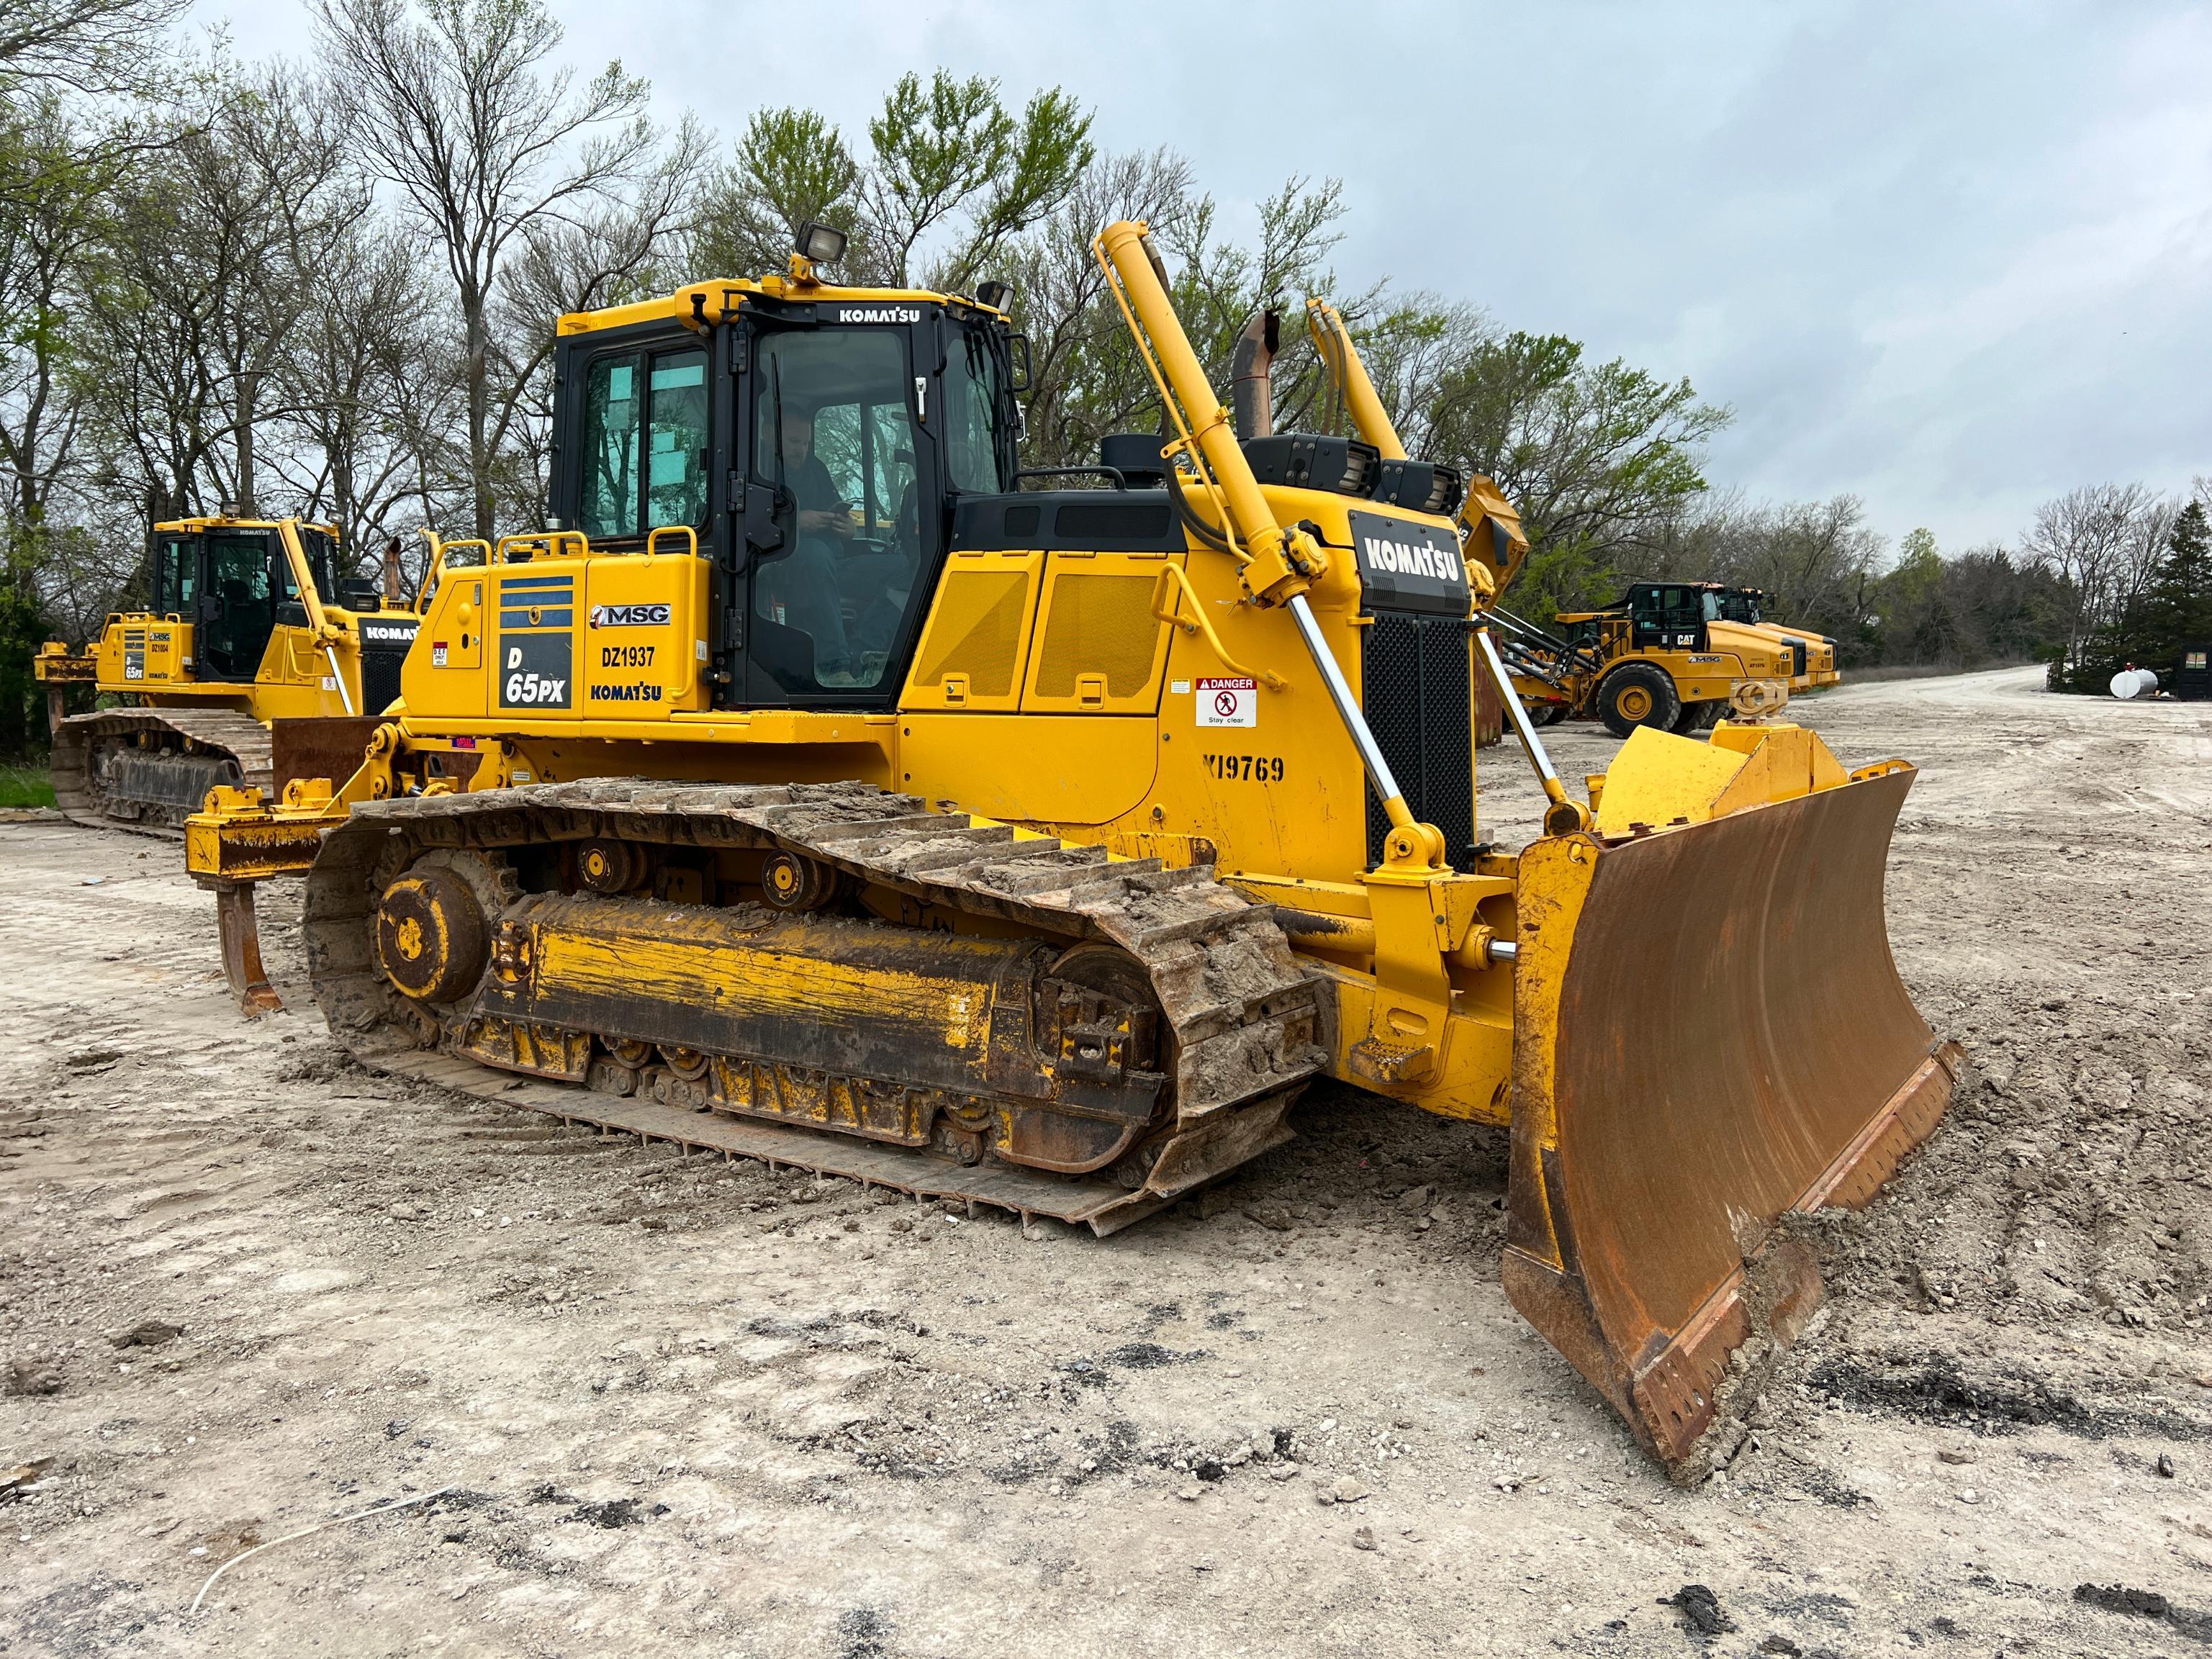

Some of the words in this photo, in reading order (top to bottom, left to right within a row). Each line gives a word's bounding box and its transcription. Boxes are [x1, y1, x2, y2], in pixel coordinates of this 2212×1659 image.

[839, 306, 920, 322] KOMATSU
[1364, 537, 1459, 582] KOMATSU
[608, 607, 669, 623] MSG
[1677, 635, 1695, 645] CAT
[126, 656, 131, 666] D
[507, 647, 522, 669] D
[602, 646, 655, 667] DZ1937
[126, 666, 143, 679] 65PX
[506, 673, 566, 703] 65PX
[591, 681, 662, 701] KOMATSU
[1211, 679, 1253, 689] DANGER
